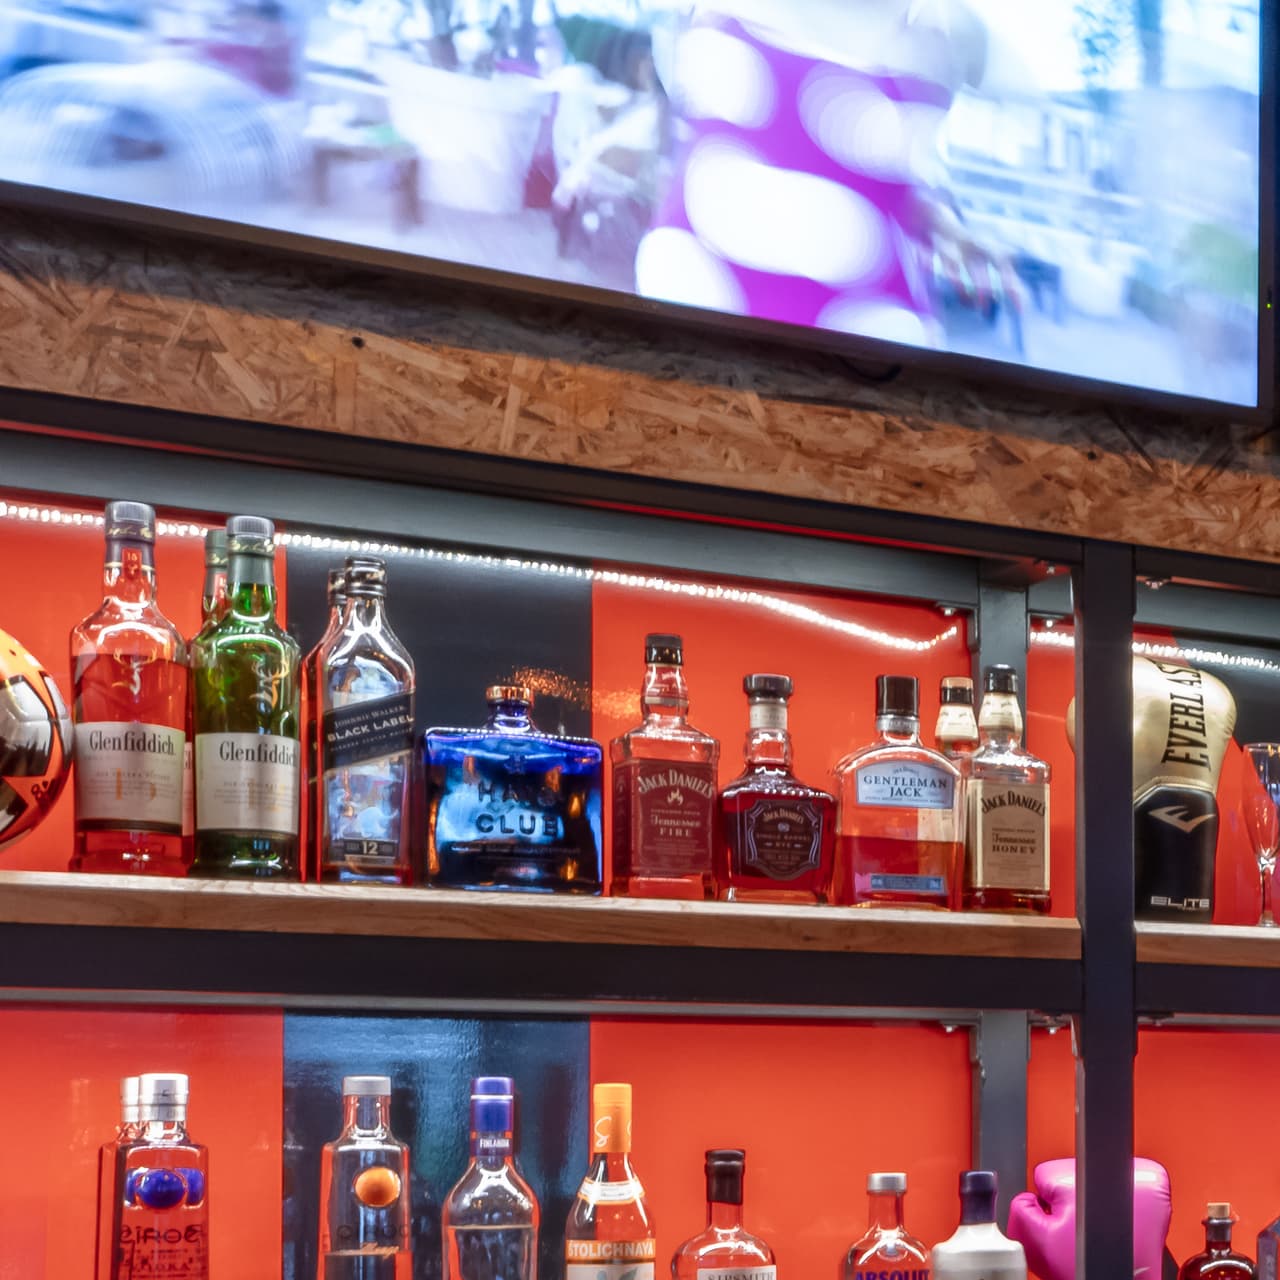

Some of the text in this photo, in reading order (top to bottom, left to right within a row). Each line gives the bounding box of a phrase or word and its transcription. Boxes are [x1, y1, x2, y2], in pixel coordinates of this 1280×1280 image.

[327, 714, 415, 742] BLACK LABEL
[219, 741, 297, 768] Glenfiddic
[637, 768, 713, 799] JACK DANIEL'S
[863, 775, 948, 789] GENTLEMAN
[889, 786, 923, 798] JACK
[981, 793, 1007, 815] JACK
[659, 828, 692, 837] FIRE
[360, 840, 379, 856] 12
[992, 845, 1036, 854] HONEY
[1150, 896, 1210, 909] ELITE
[568, 1239, 655, 1257] STOLICHNAYA
